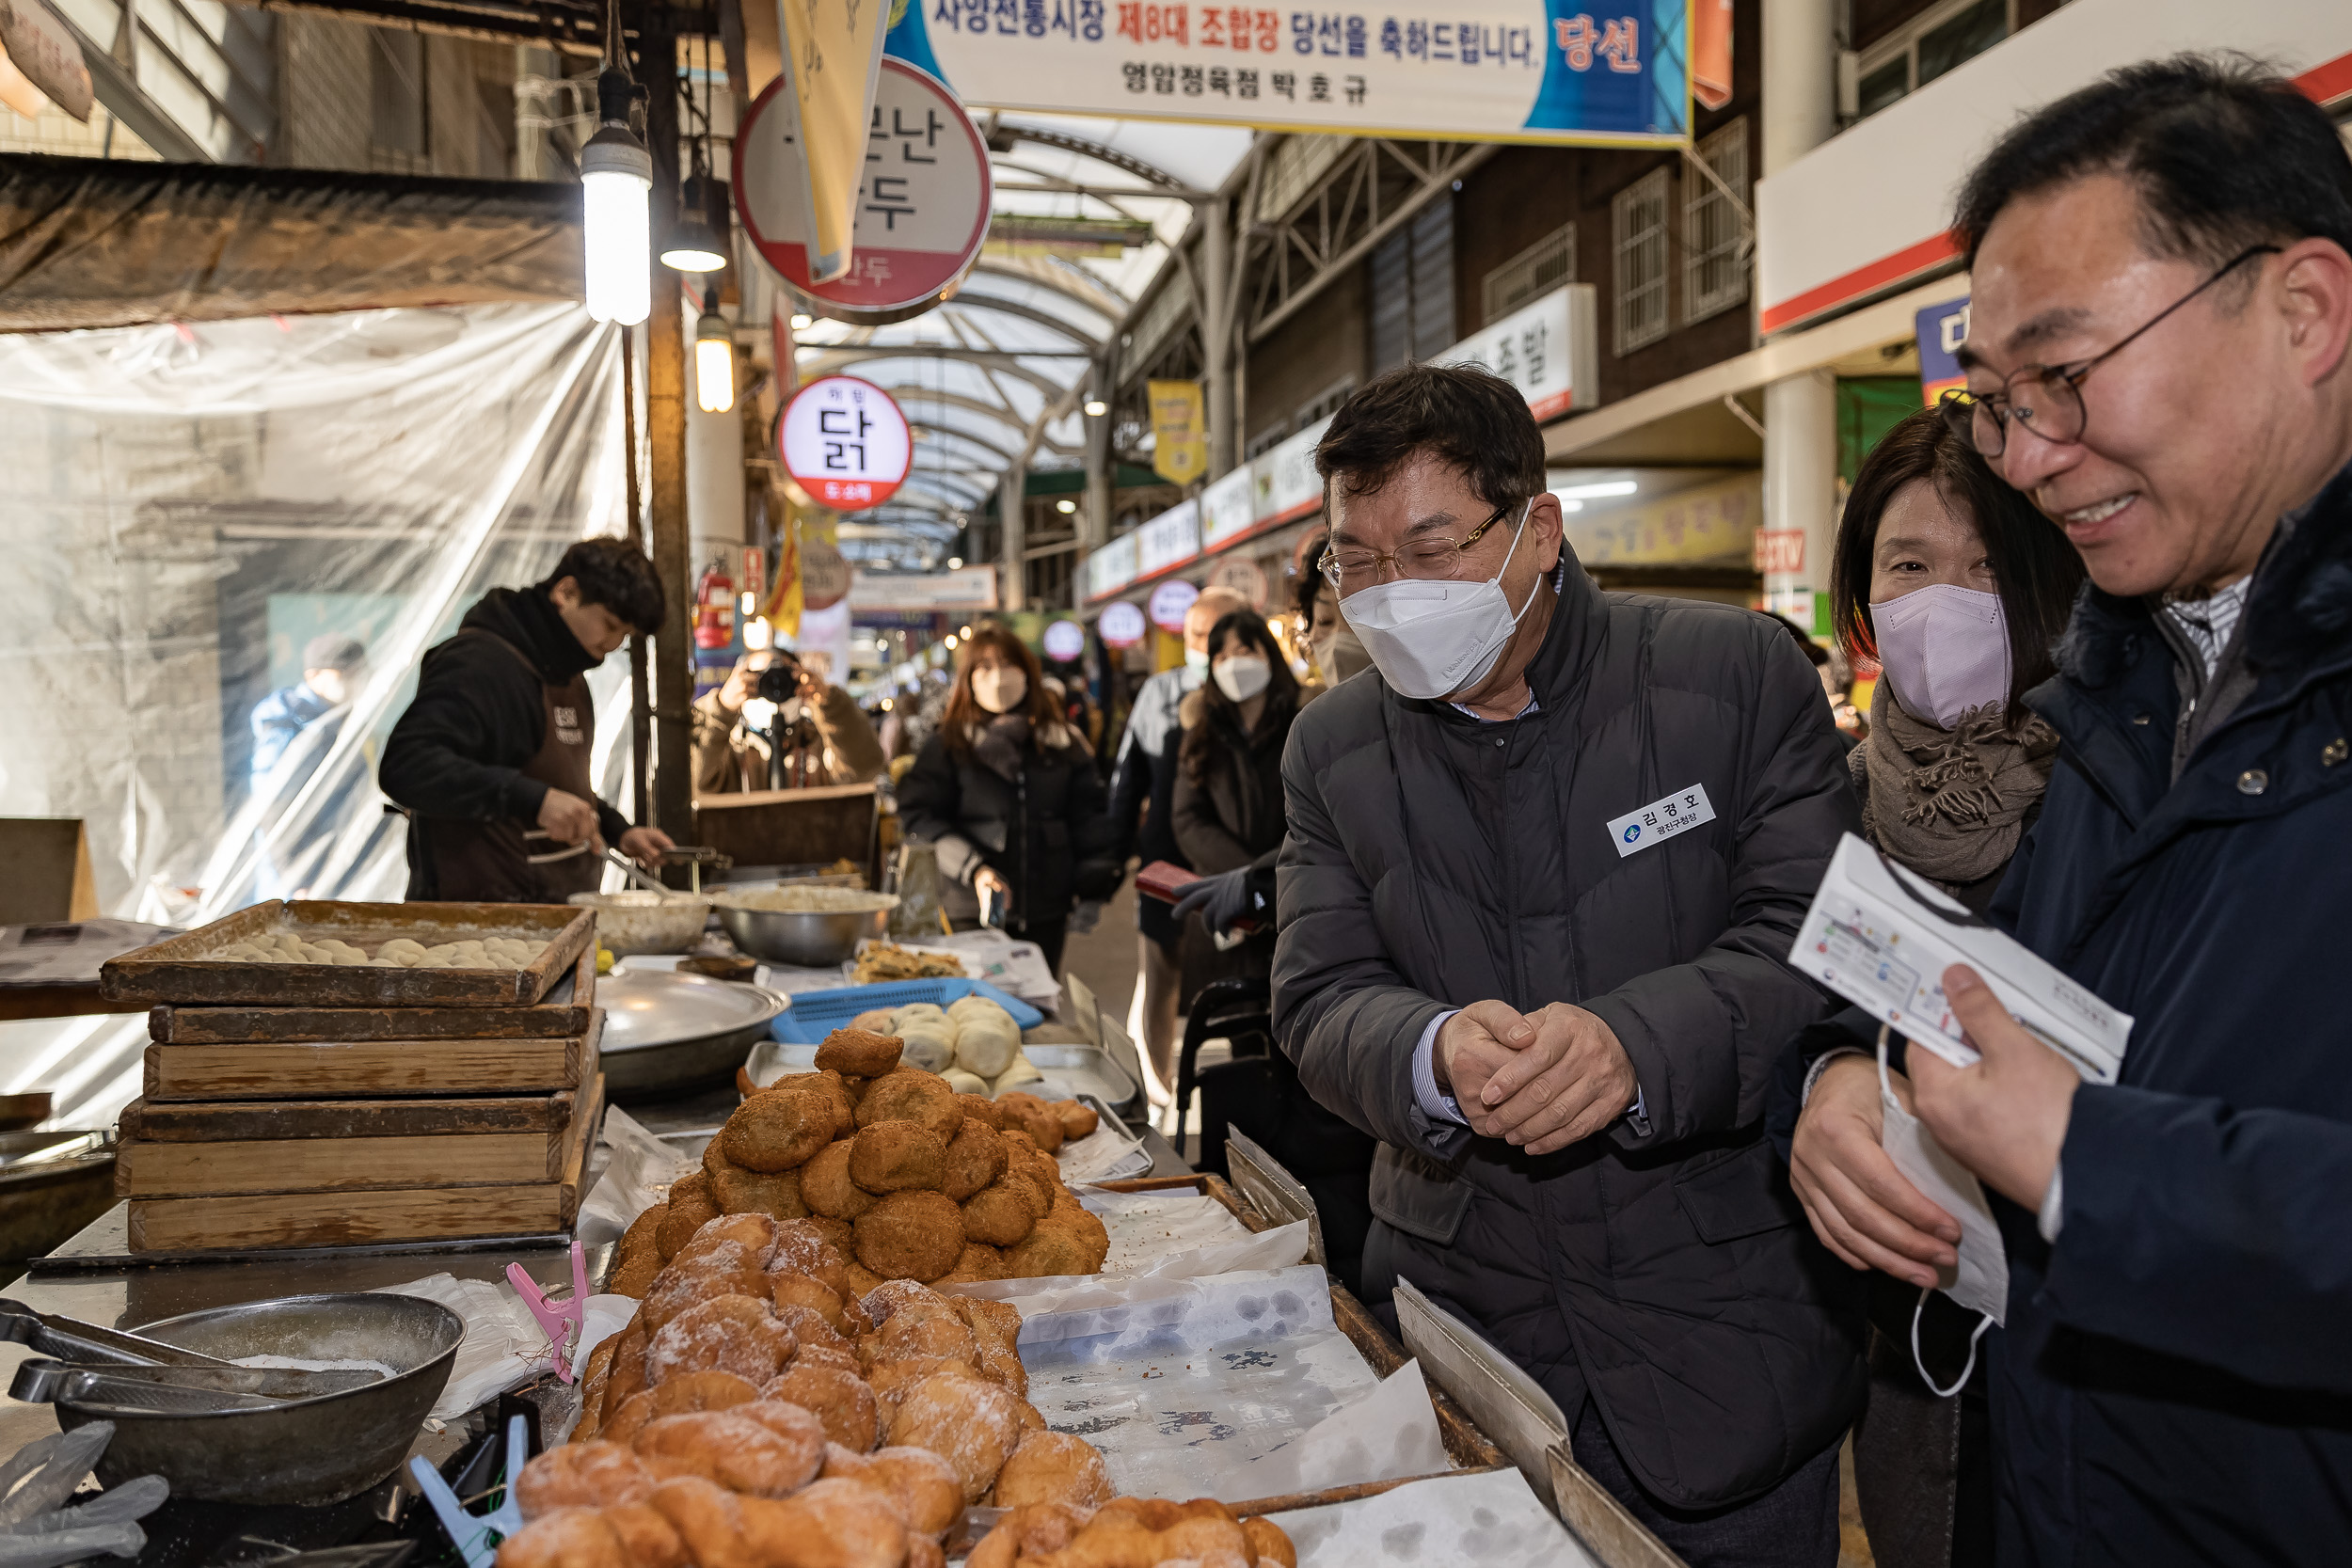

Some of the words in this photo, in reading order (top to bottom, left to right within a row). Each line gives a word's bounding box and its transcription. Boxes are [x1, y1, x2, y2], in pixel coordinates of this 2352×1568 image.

[1117, 2, 1189, 47] 제8대
[1200, 7, 1279, 54] 조합장
[1291, 11, 1367, 58] 당선을
[1379, 15, 1538, 69] 축하드립니다.
[1553, 13, 1642, 72] 당선
[818, 408, 874, 471] 닭
[1656, 812, 1698, 835] 광진구청장
